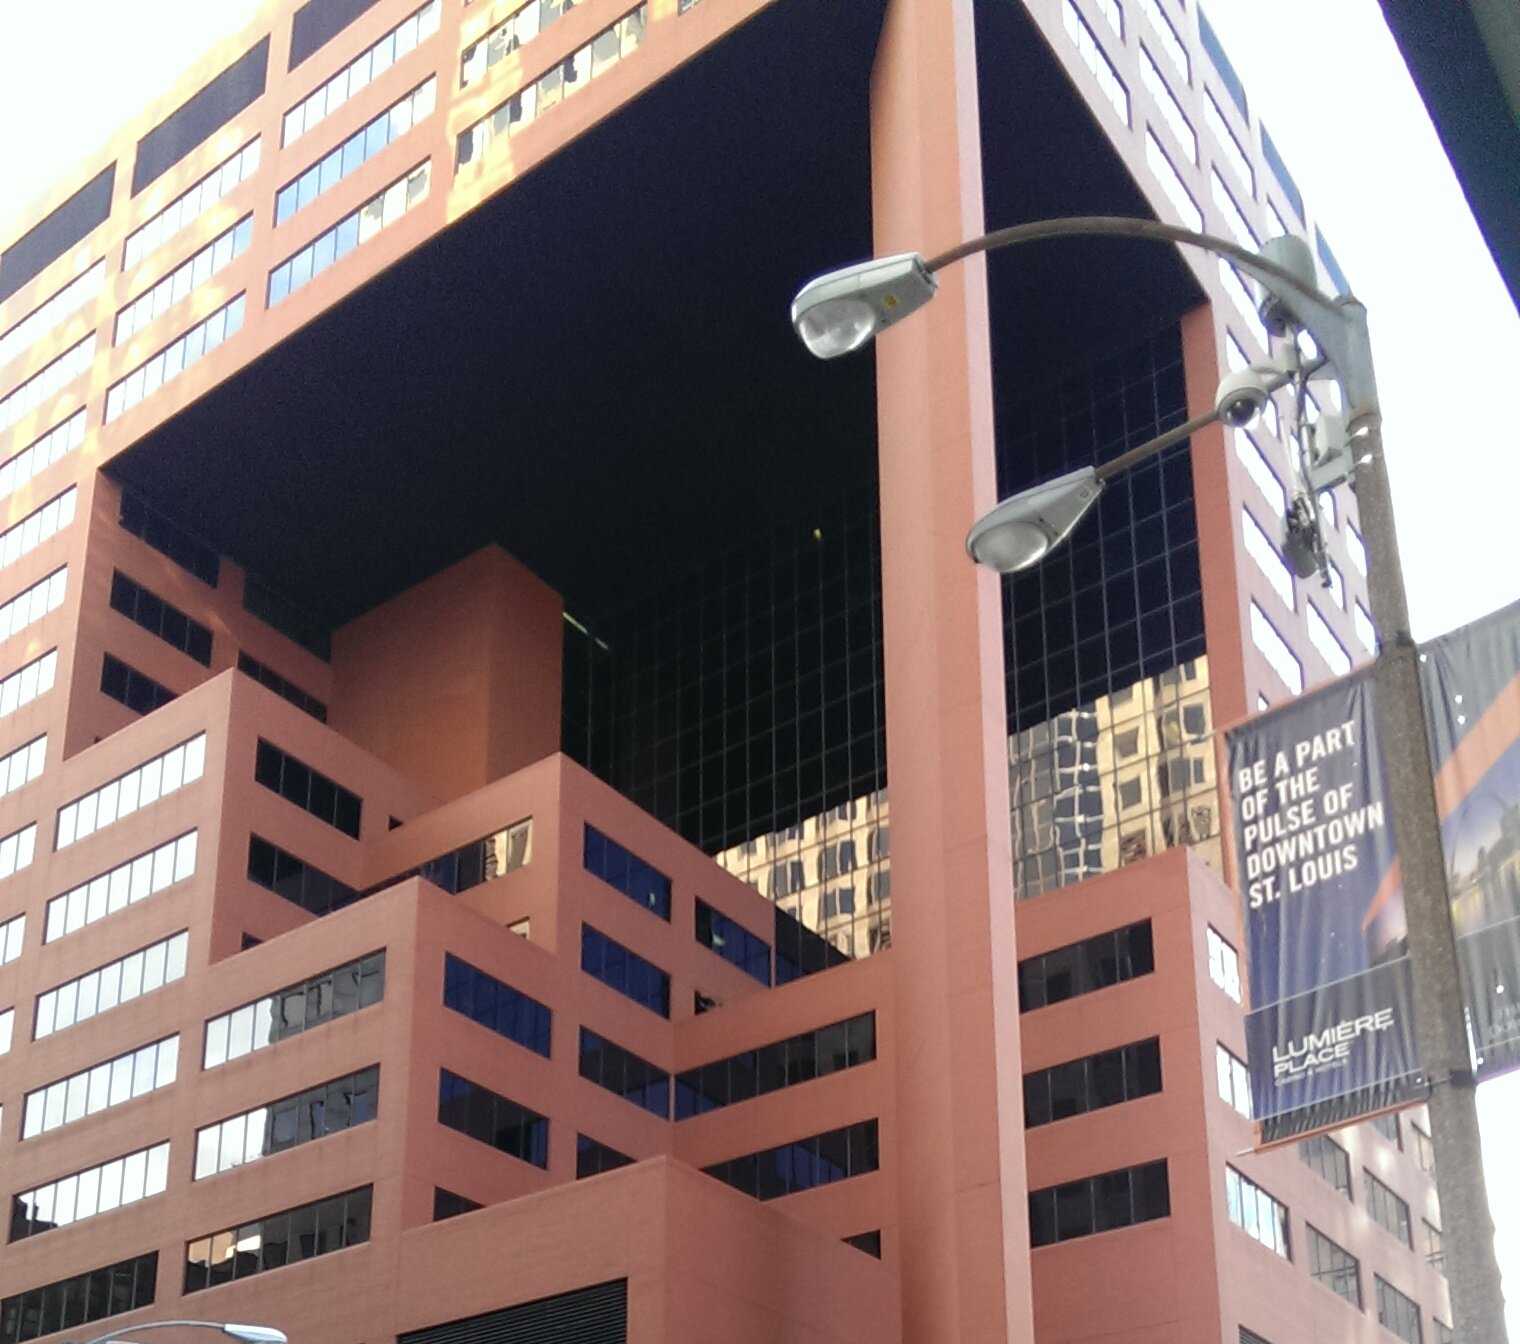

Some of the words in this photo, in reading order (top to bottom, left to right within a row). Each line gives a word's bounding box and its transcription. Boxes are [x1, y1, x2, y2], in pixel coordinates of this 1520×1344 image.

[1238, 760, 1267, 793] BE
[1274, 751, 1290, 778] A
[1295, 720, 1355, 767] PART
[1241, 788, 1268, 821] OF
[1275, 766, 1320, 805] THE
[1244, 799, 1316, 851] PULSE
[1323, 783, 1353, 815] OF
[1246, 801, 1384, 880] DOWNTOWN
[1249, 876, 1281, 908] ST.
[1288, 844, 1358, 892] LOUIS
[1274, 1042, 1350, 1077] PLACE
